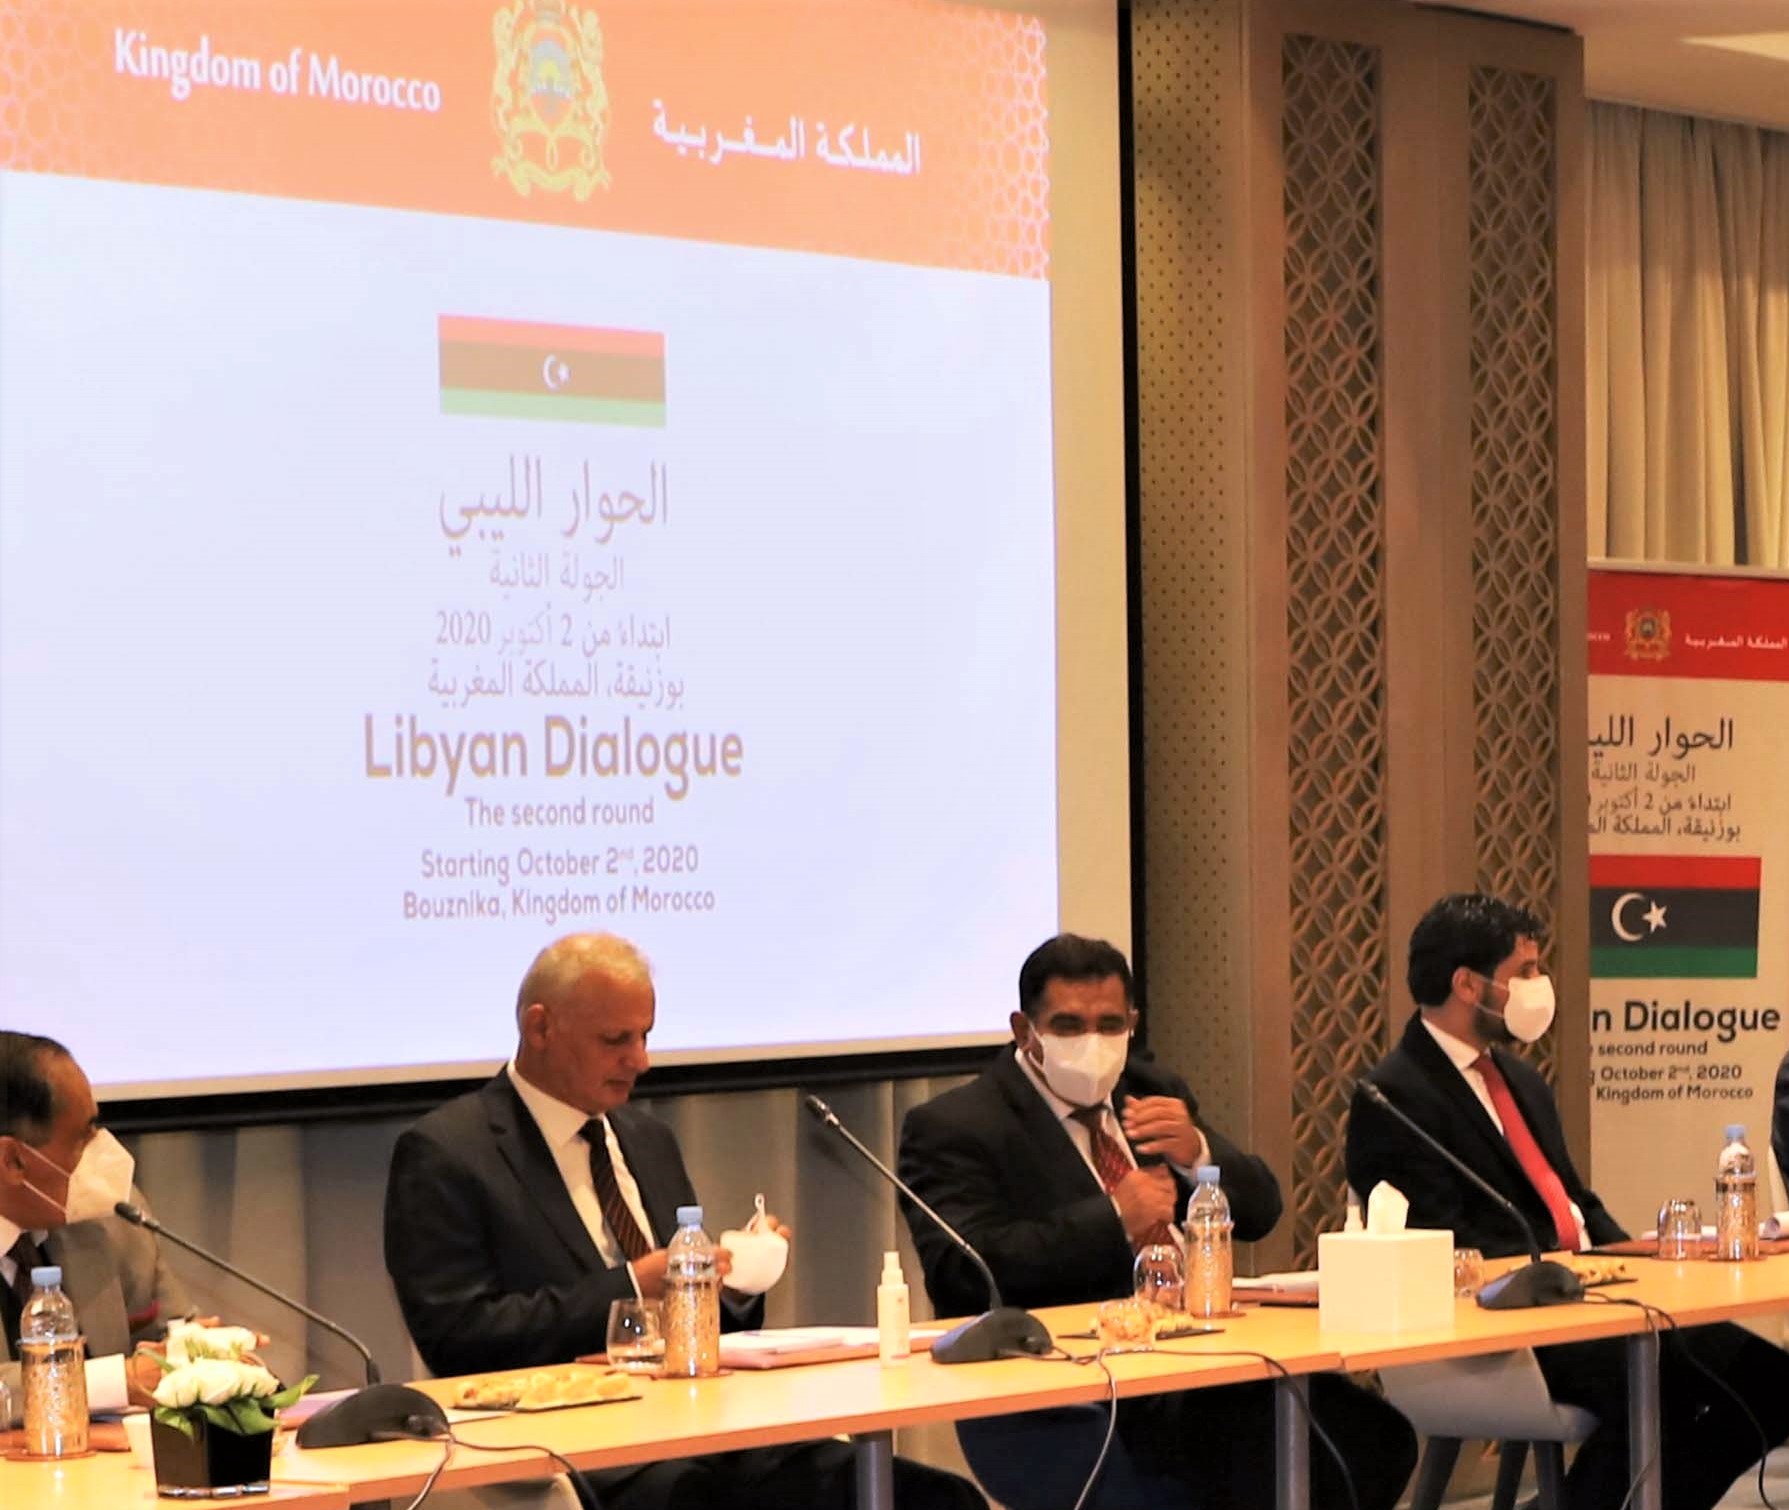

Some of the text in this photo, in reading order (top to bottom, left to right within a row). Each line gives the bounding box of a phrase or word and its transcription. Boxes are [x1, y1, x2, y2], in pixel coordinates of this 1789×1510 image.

[114, 28, 442, 112] Kingdom of Morocco
[652, 98, 922, 174] المملكة المغربية
[439, 453, 667, 558] الحوار الليبي
[489, 549, 624, 602] الجولة الثانية
[436, 609, 492, 646] 2020
[499, 602, 552, 655] أكتوبر
[561, 613, 573, 647] 2
[582, 620, 611, 657] من
[428, 657, 512, 707] المغربية
[523, 660, 598, 696] المملكة
[364, 713, 744, 800] Libyan Dialogue
[1650, 717, 1733, 759] الحوار
[1645, 761, 1696, 788] الجولة
[464, 797, 655, 826] The second round
[1644, 792, 1654, 810] 2
[1659, 794, 1683, 817] من
[1613, 813, 1671, 836] المملكة
[421, 848, 510, 886] Starting
[516, 846, 599, 877] October
[642, 844, 699, 873] 2020
[402, 885, 716, 926] Bouznika, Kingdom of Morocco
[1624, 1000, 1781, 1043] Dialogue
[1598, 1040, 1656, 1056] second
[1660, 1040, 1709, 1056] round
[1600, 1065, 1665, 1082] October
[1696, 1064, 1743, 1080] 2020
[1596, 1084, 1754, 1106] Kingdom of Morocco
